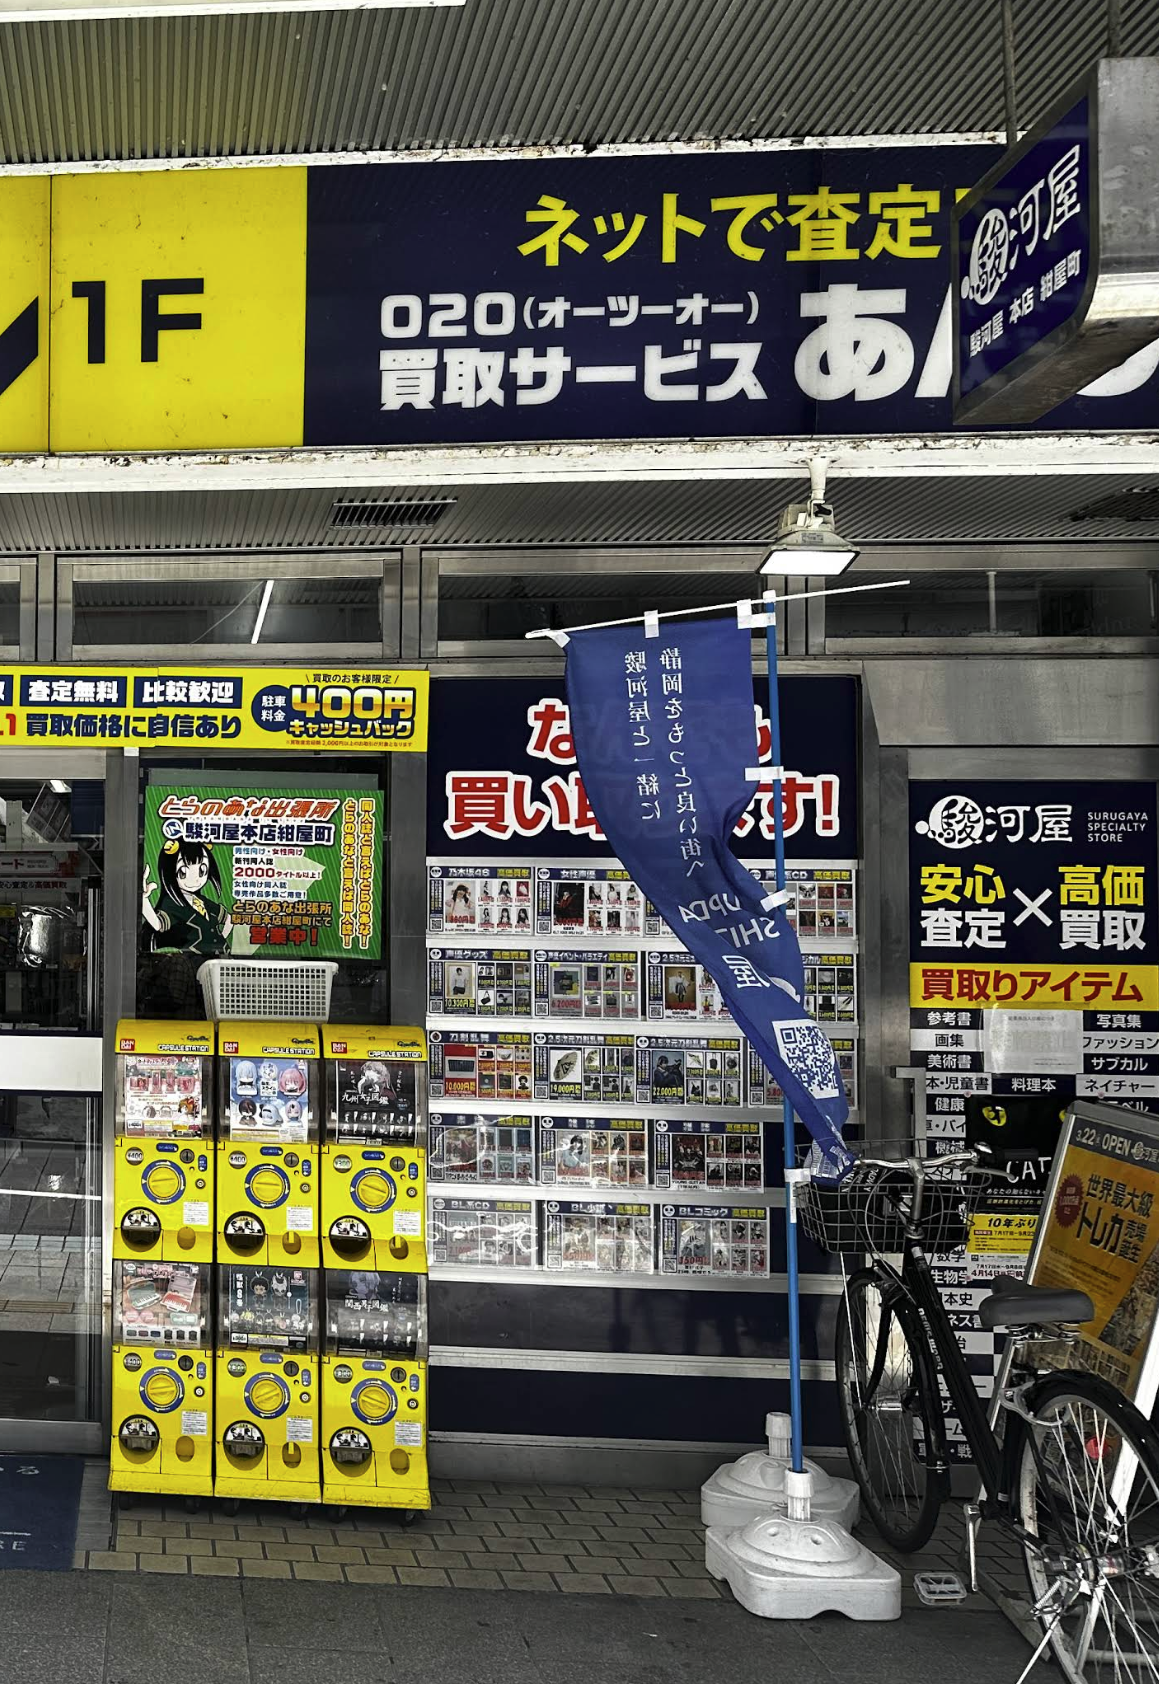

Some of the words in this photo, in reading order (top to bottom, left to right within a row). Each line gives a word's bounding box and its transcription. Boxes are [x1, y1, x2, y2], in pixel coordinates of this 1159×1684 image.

[517, 183, 972, 267] ネットで査定
[969, 310, 1004, 358] 駿河屋
[1009, 286, 1034, 324] 本店
[1040, 249, 1082, 302] 紺屋町
[72, 277, 204, 364] 1F
[380, 344, 768, 411] 買取サービス
[313, 673, 392, 684] 買取のお客様限定
[28, 680, 119, 704] 査定無料
[141, 681, 236, 705] 比較歓迎
[262, 695, 287, 708] 駐車
[292, 687, 414, 720] 400円
[261, 709, 286, 722] 料金
[26, 713, 243, 740] 買取価格に自信あり
[289, 720, 412, 737] キャッシュバック
[160, 797, 338, 819] とらのあな出張所
[1088, 812, 1148, 821] SURUGAYA
[915, 795, 1073, 849] 駿河屋
[1088, 822, 1147, 832] SPECIALTY
[186, 822, 332, 843] 駿河屋本店紺屋町
[1088, 833, 1123, 842] STORE
[235, 847, 303, 856] 男性向け・女性向け
[921, 863, 1006, 904] 安心
[1059, 865, 1145, 906] 高価
[232, 900, 332, 914] とらのあな出張所
[250, 926, 318, 946] 営業中!
[921, 908, 1006, 949] 査定
[1059, 909, 1146, 950] 買取
[921, 969, 1144, 1002] 買取りアイテム
[927, 1011, 972, 1026] 参考書
[1096, 1013, 1142, 1028] 写真集
[935, 1034, 964, 1047] 画集
[1083, 1036, 1159, 1049] ファッション
[927, 1054, 972, 1068] 美術書
[1091, 1057, 1148, 1071] サブカル
[925, 1076, 989, 1091] 本・児童書
[1011, 1077, 1056, 1092] 料理本
[1085, 1078, 1155, 1093] ネイチャー
[935, 1097, 965, 1111] 健康
[1102, 1133, 1132, 1157] OPEN
[1007, 1157, 1052, 1183] CAT
[1085, 1173, 1154, 1218] 世界最大級
[1076, 1201, 1125, 1256] トレカ
[941, 1292, 973, 1306] 本史
